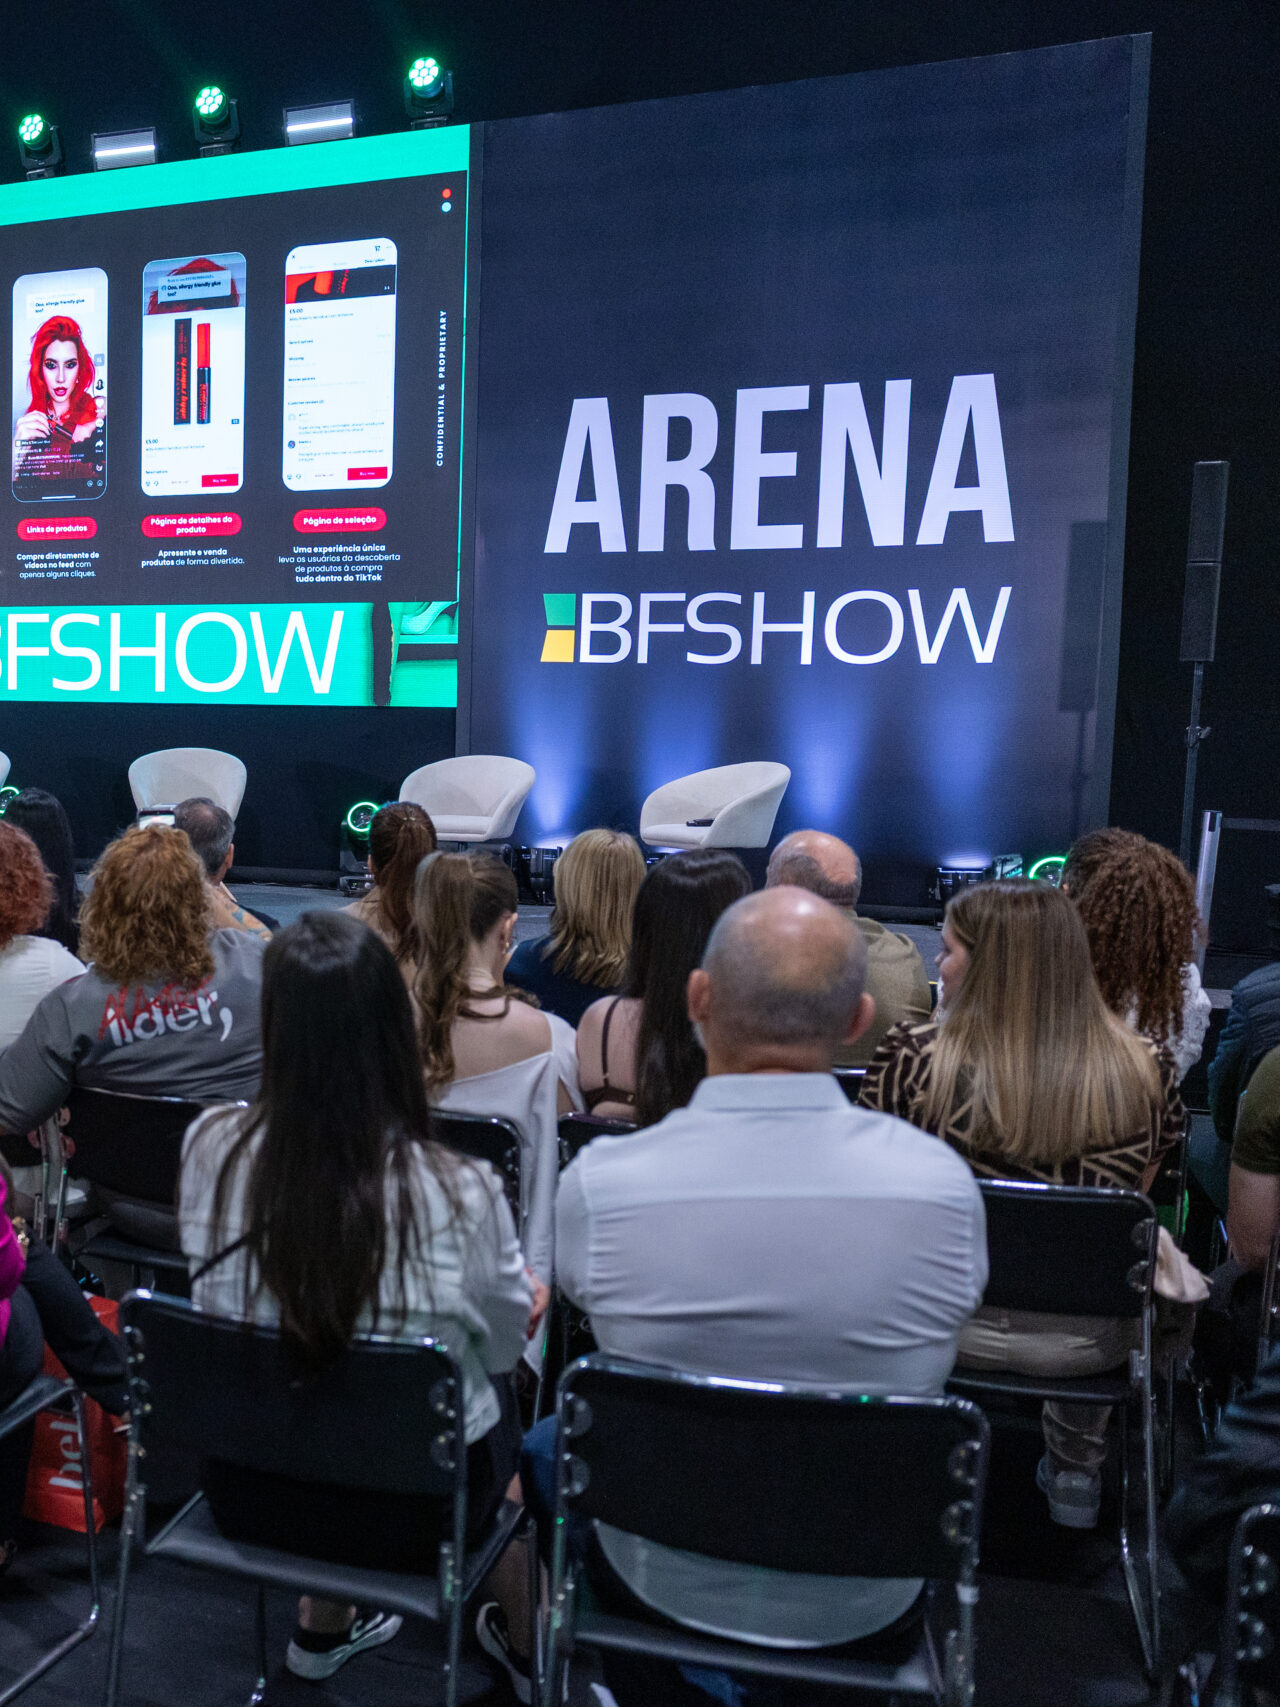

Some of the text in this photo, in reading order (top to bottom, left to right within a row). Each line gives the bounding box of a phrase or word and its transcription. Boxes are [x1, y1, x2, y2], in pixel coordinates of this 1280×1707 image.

[438, 310, 447, 378] PROPRIETARY
[436, 394, 445, 467] CONFIDENTIAL
[544, 373, 1015, 553] ARENA
[150, 517, 176, 526] Página
[188, 516, 221, 524] detalhes
[303, 517, 332, 527] Página
[345, 516, 376, 525] seleção
[26, 526, 44, 534] Links
[56, 524, 88, 534] produtos
[176, 526, 206, 535] produto
[158, 550, 196, 558] Apresente
[313, 544, 360, 554] experiência
[362, 543, 386, 551] única
[141, 558, 174, 568] produtos
[210, 556, 245, 565] divertida.
[46, 570, 69, 579] alguns
[70, 570, 96, 579] cliques.
[307, 565, 342, 574] produtos
[351, 564, 382, 573] compra
[579, 586, 1012, 665] BFSHOW
